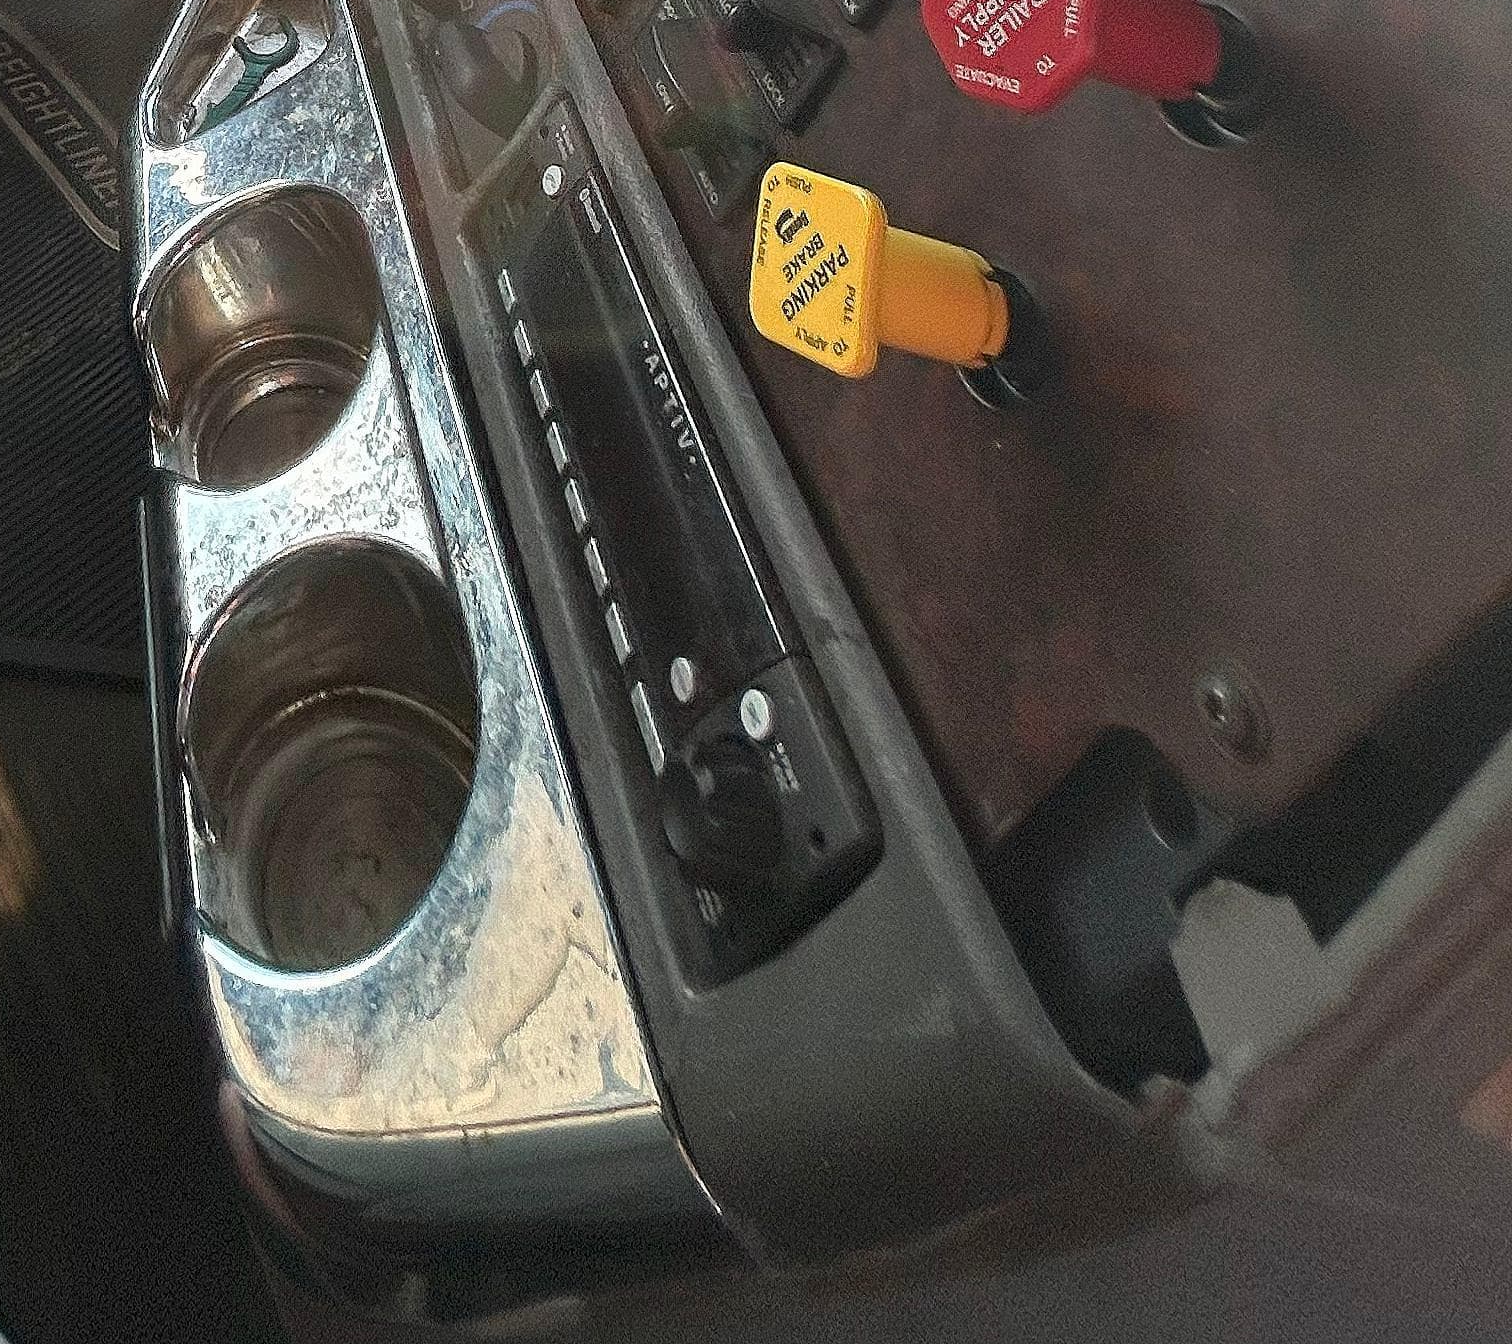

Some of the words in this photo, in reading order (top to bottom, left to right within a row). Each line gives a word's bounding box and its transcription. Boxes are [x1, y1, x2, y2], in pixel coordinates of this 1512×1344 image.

[954, 64, 1021, 95] EVACUATE
[1035, 54, 1056, 75] TO
[767, 175, 781, 193] TO
[785, 175, 813, 196] PUSH
[756, 198, 772, 267] RELEASE
[781, 231, 826, 284] BRAKE
[780, 243, 850, 322] PARKING
[841, 283, 857, 325] PULL
[794, 325, 829, 353] APPLY
[832, 338, 850, 357] TO
[645, 353, 694, 450] APTIV
